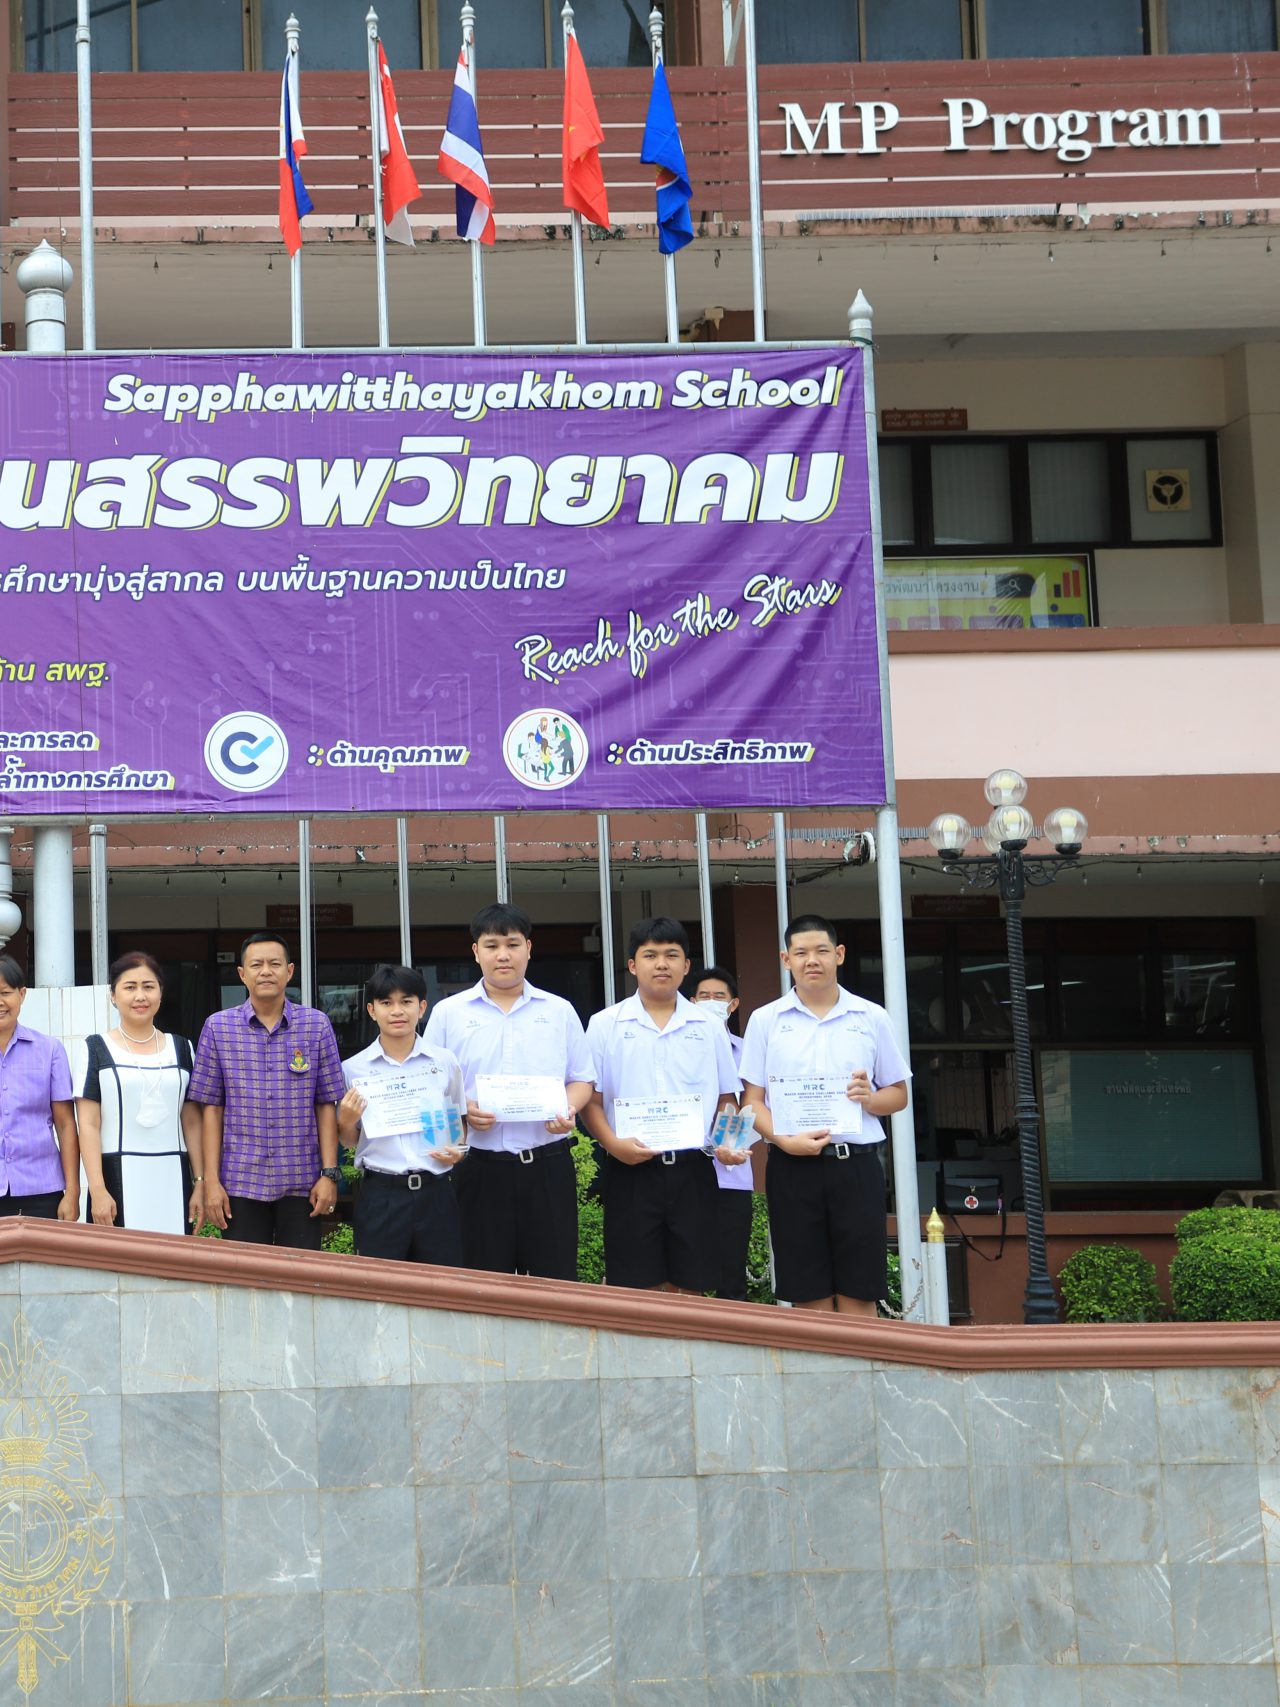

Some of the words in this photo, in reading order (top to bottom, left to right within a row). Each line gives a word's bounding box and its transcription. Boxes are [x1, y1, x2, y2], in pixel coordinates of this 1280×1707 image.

[779, 102, 900, 156] MP
[943, 97, 1221, 162] Program
[103, 370, 660, 422] Sapphawitthayakhom
[671, 365, 841, 409] School
[236, 553, 567, 599] บนพื้นฐานความเป็นไทย
[514, 617, 621, 684] Reach
[626, 609, 676, 679] for
[672, 591, 736, 638] the
[743, 573, 840, 627] Stars
[45, 659, 111, 688] สพฐ.
[327, 740, 467, 772] ด้านคุณภาพ
[627, 740, 812, 765] ด้านประสิทธิภาพ
